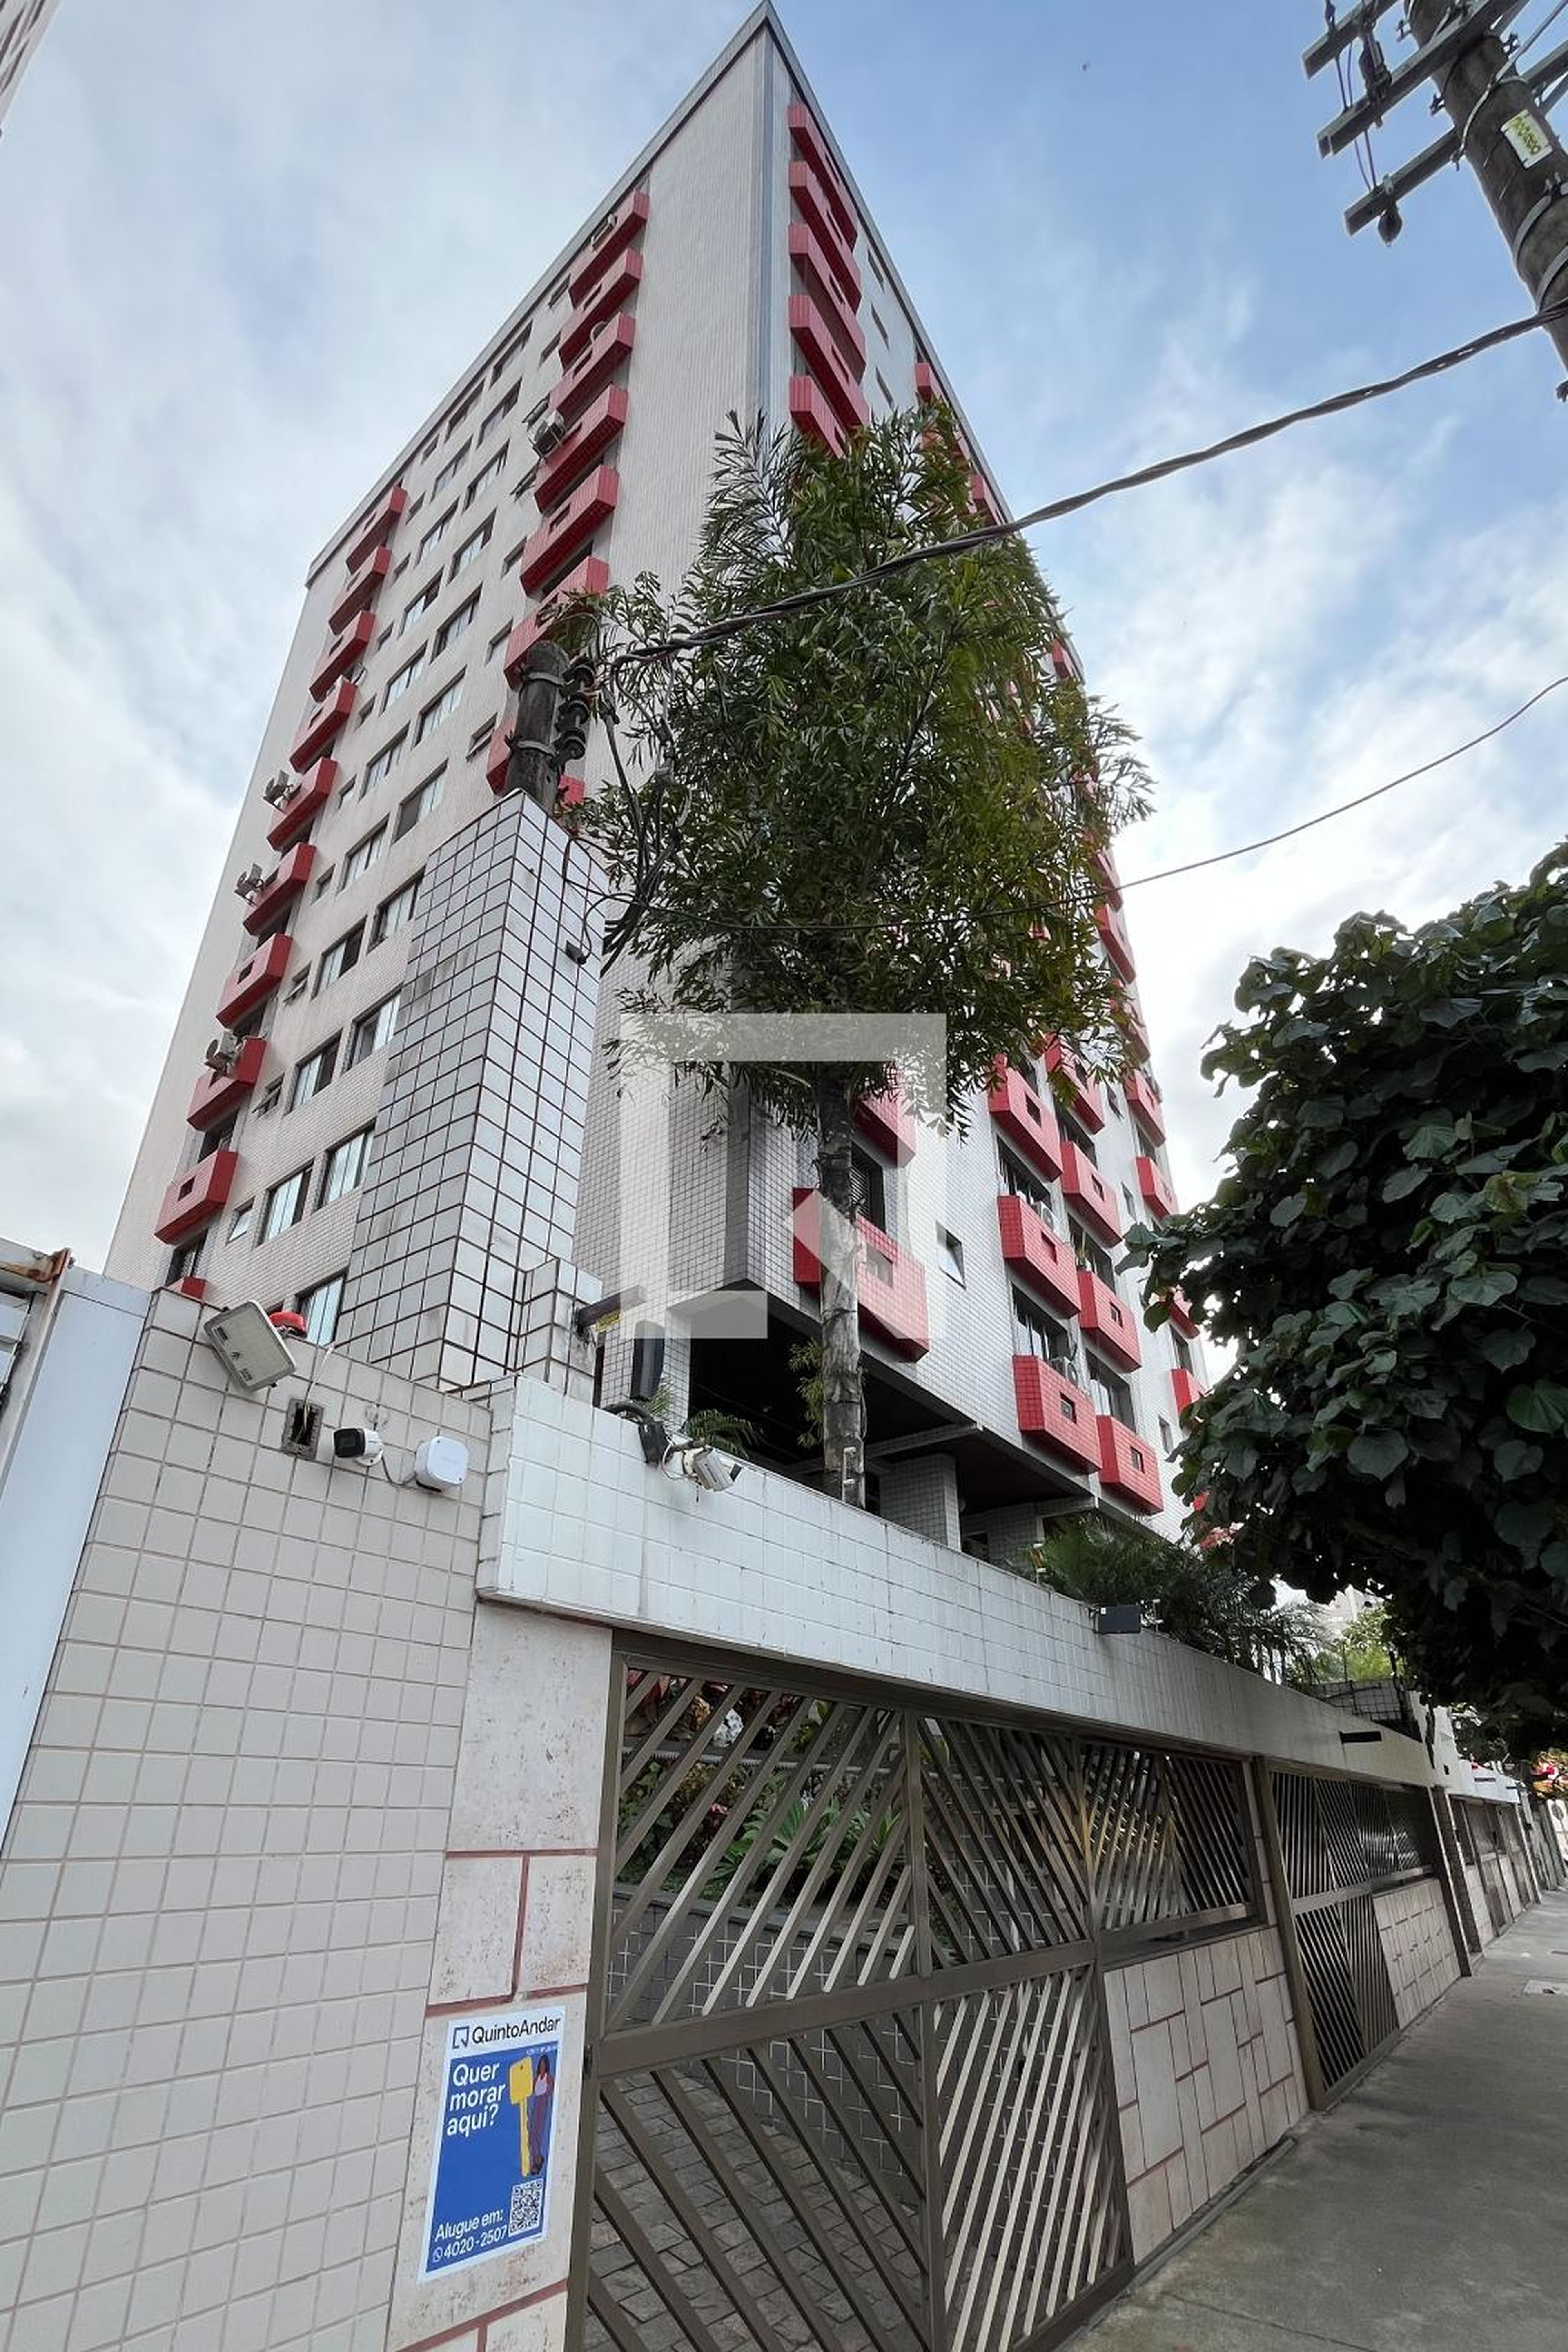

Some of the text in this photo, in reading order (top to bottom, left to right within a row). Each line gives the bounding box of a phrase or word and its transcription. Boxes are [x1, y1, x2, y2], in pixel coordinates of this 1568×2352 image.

[472, 2016, 561, 2044] QuintoAndar
[453, 2063, 500, 2087] Quer
[450, 2084, 506, 2111] morar
[447, 2103, 499, 2138] aqui?
[434, 2209, 503, 2242] Alugue em:
[444, 2225, 507, 2259] 4020-2507
